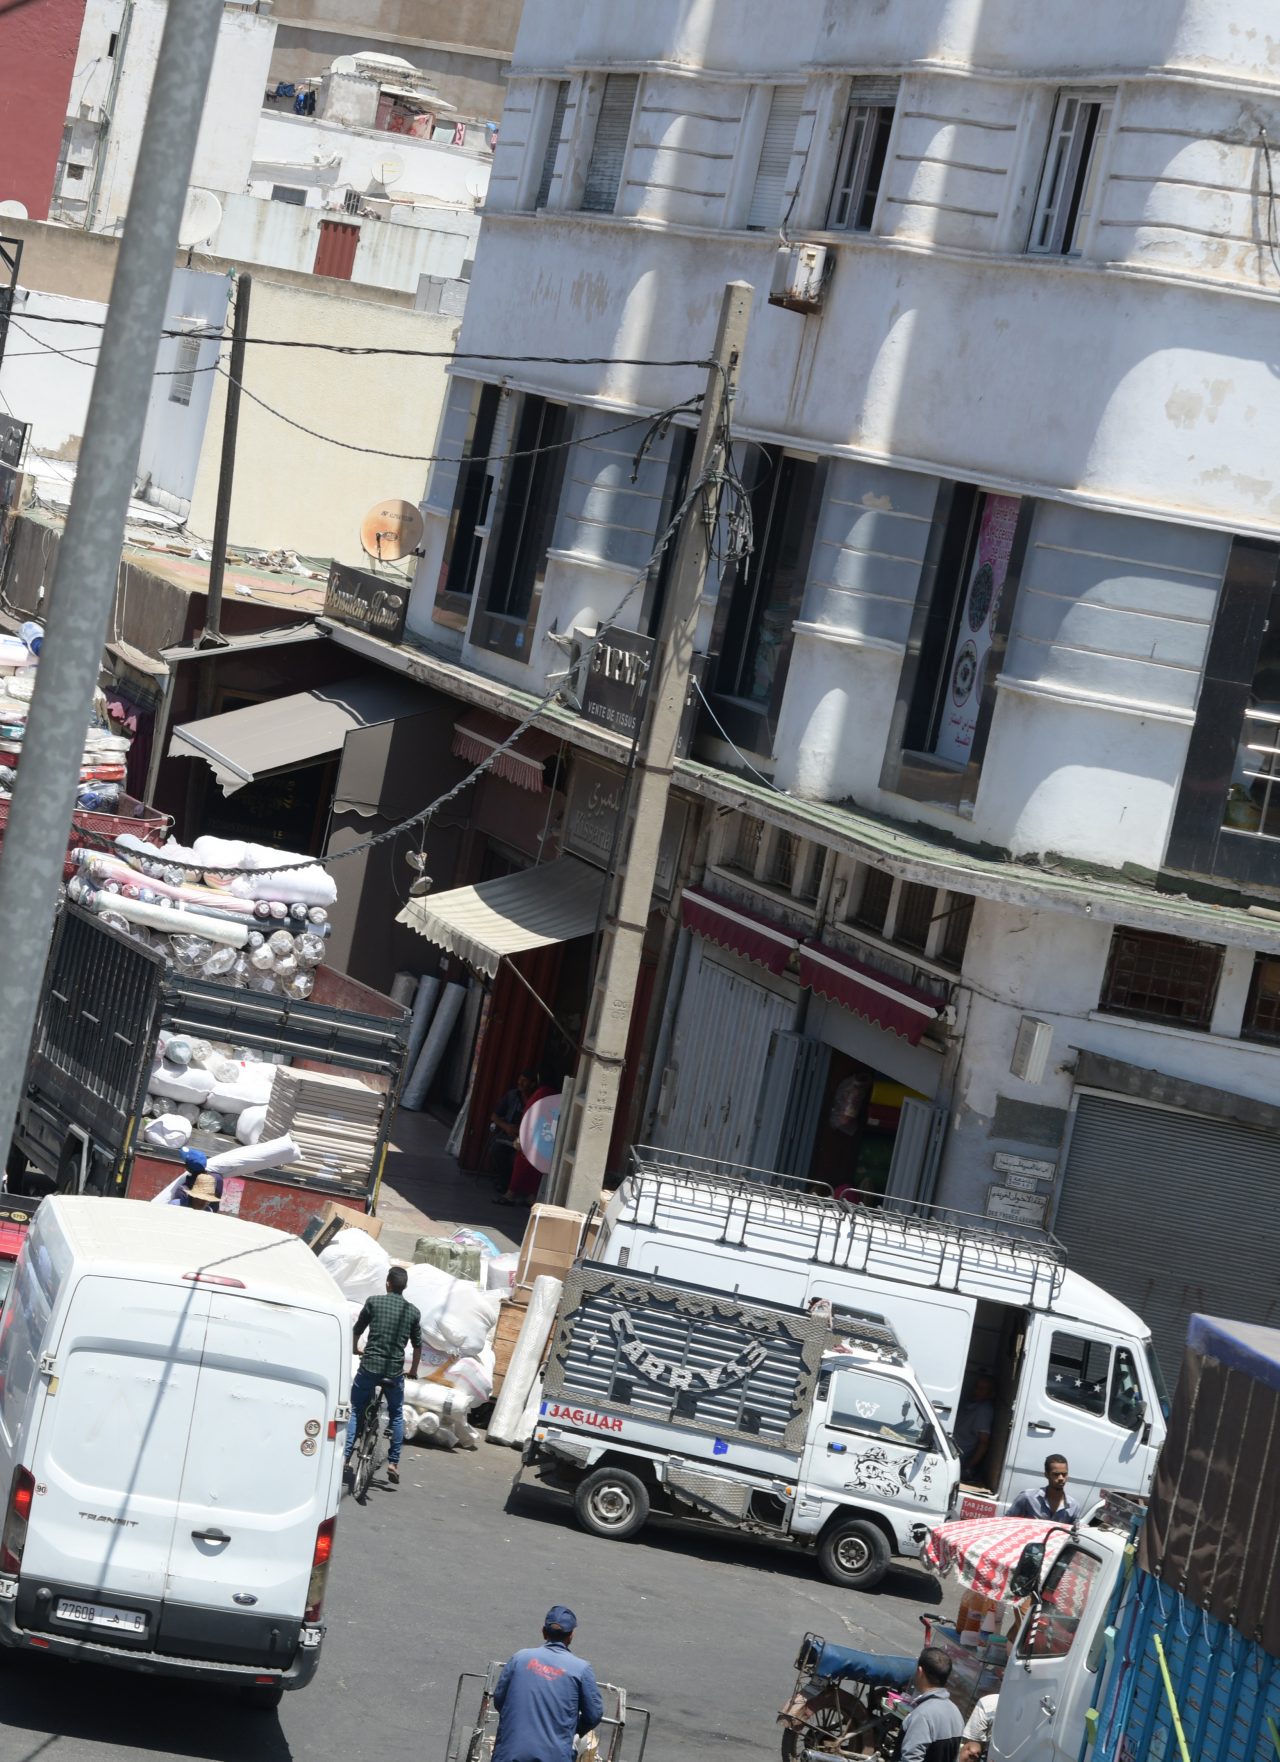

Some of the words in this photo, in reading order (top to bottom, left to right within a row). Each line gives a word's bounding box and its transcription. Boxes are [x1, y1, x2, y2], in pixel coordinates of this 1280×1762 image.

[587, 701, 606, 719] VENTE
[606, 709, 615, 721] DE
[615, 711, 637, 729] TISSUS
[610, 1310, 727, 1392] CARRY
[549, 1404, 624, 1432] JAGUAR
[36, 1485, 47, 1494] 90
[78, 1511, 139, 1527] TRANSIT
[61, 1602, 96, 1621] 77608
[134, 1615, 142, 1629] 6
